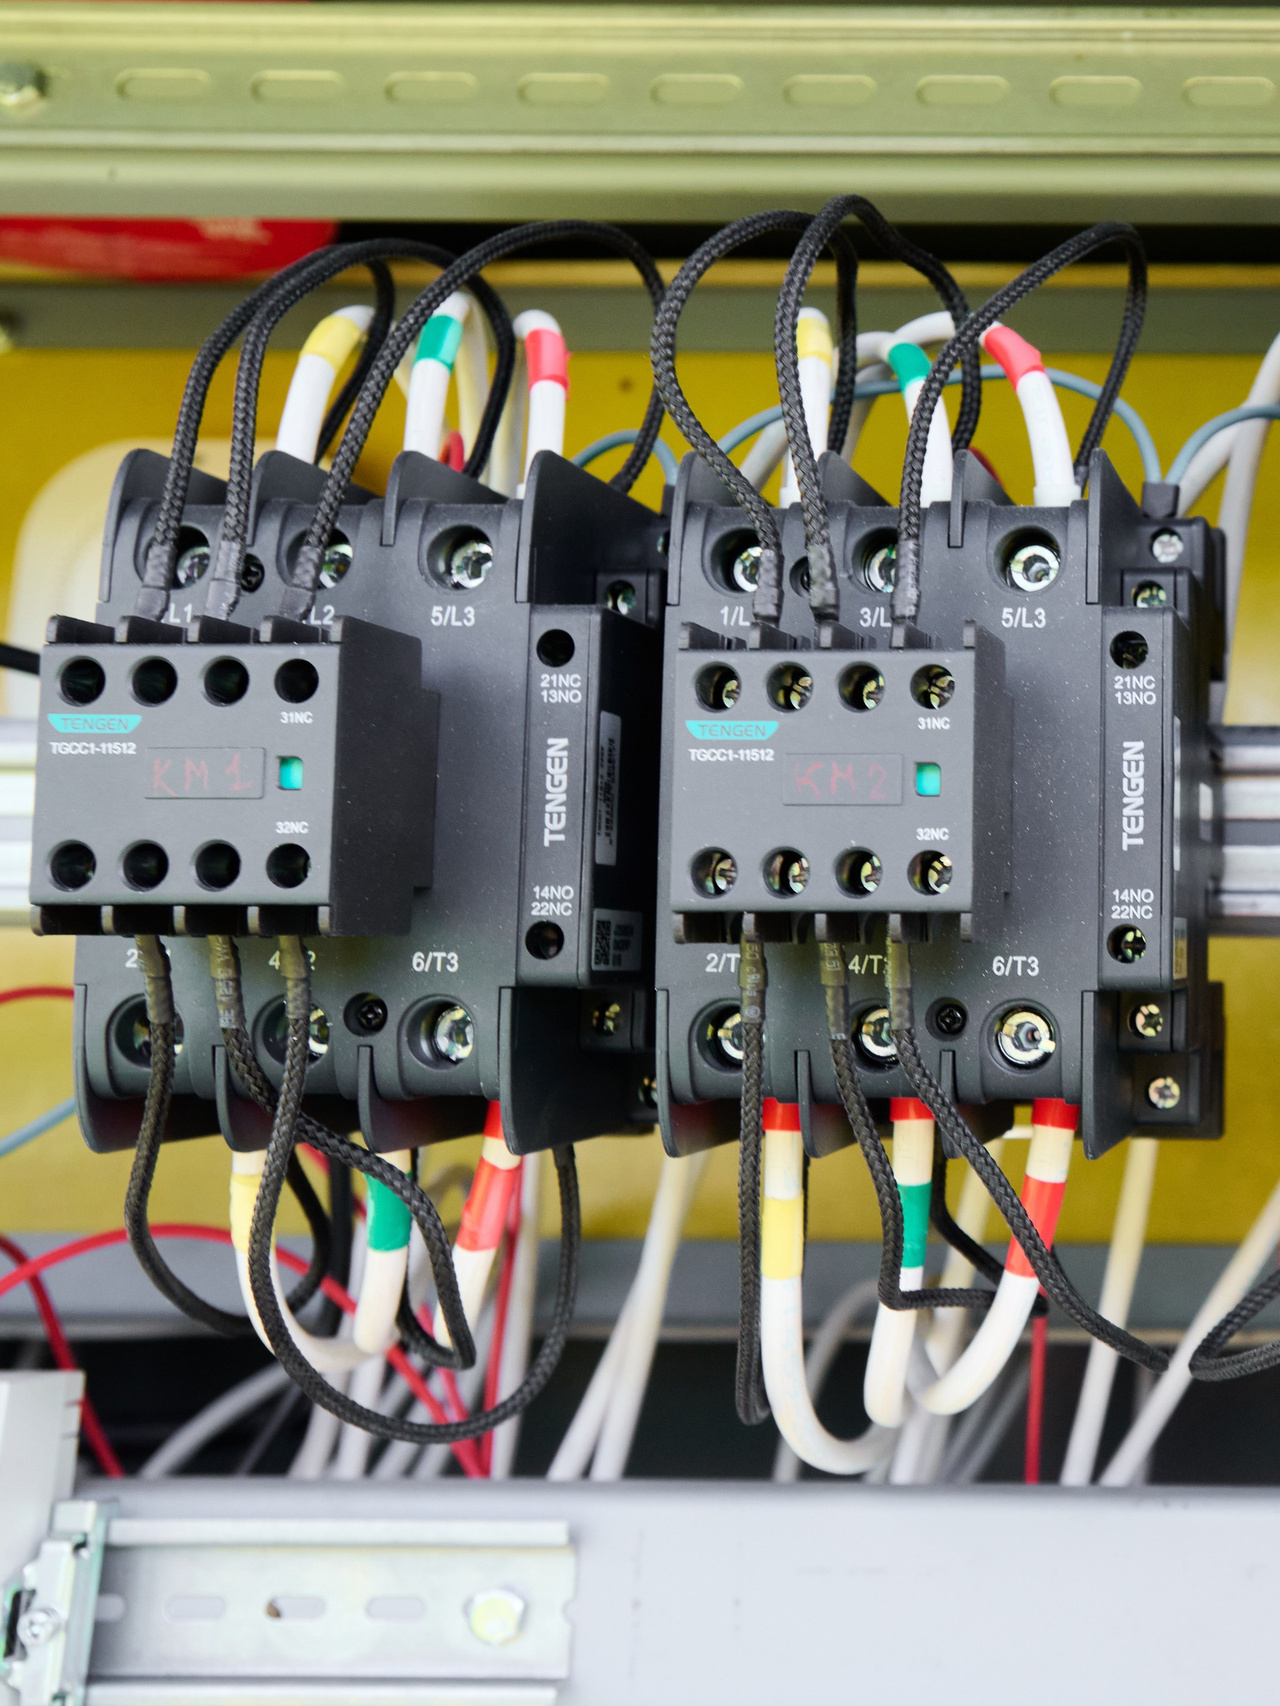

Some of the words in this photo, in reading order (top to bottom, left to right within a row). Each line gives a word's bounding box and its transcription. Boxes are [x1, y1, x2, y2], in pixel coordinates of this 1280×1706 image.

[430, 605, 476, 627] 5/L3
[720, 605, 750, 627] 1/L
[859, 606, 892, 628] 3/L
[1001, 606, 1047, 629] 5/L3
[540, 673, 582, 688] 21NC
[1113, 675, 1156, 690] 21NC
[541, 689, 582, 703] 13NO
[1115, 691, 1157, 705] 13NO
[61, 717, 130, 732] TENGEN
[280, 711, 313, 724] 31NC
[917, 716, 951, 730] 31NC
[697, 723, 767, 738] TENGEN
[49, 741, 137, 755] TGCC1-11512
[688, 748, 775, 762] TGCC1-11512
[543, 737, 569, 847] TENGEN
[1122, 740, 1145, 851] TENGEN
[275, 821, 309, 834] 32NC
[916, 827, 949, 841] 32NC
[533, 885, 574, 900] 14NO
[1112, 888, 1155, 904] 14NO
[531, 901, 572, 916] 22NC
[1111, 905, 1153, 920] 22NC
[412, 951, 459, 973] 6/T3
[705, 952, 741, 973] 2/T
[848, 954, 885, 975] 4/T
[992, 955, 1040, 977] 6/T3
